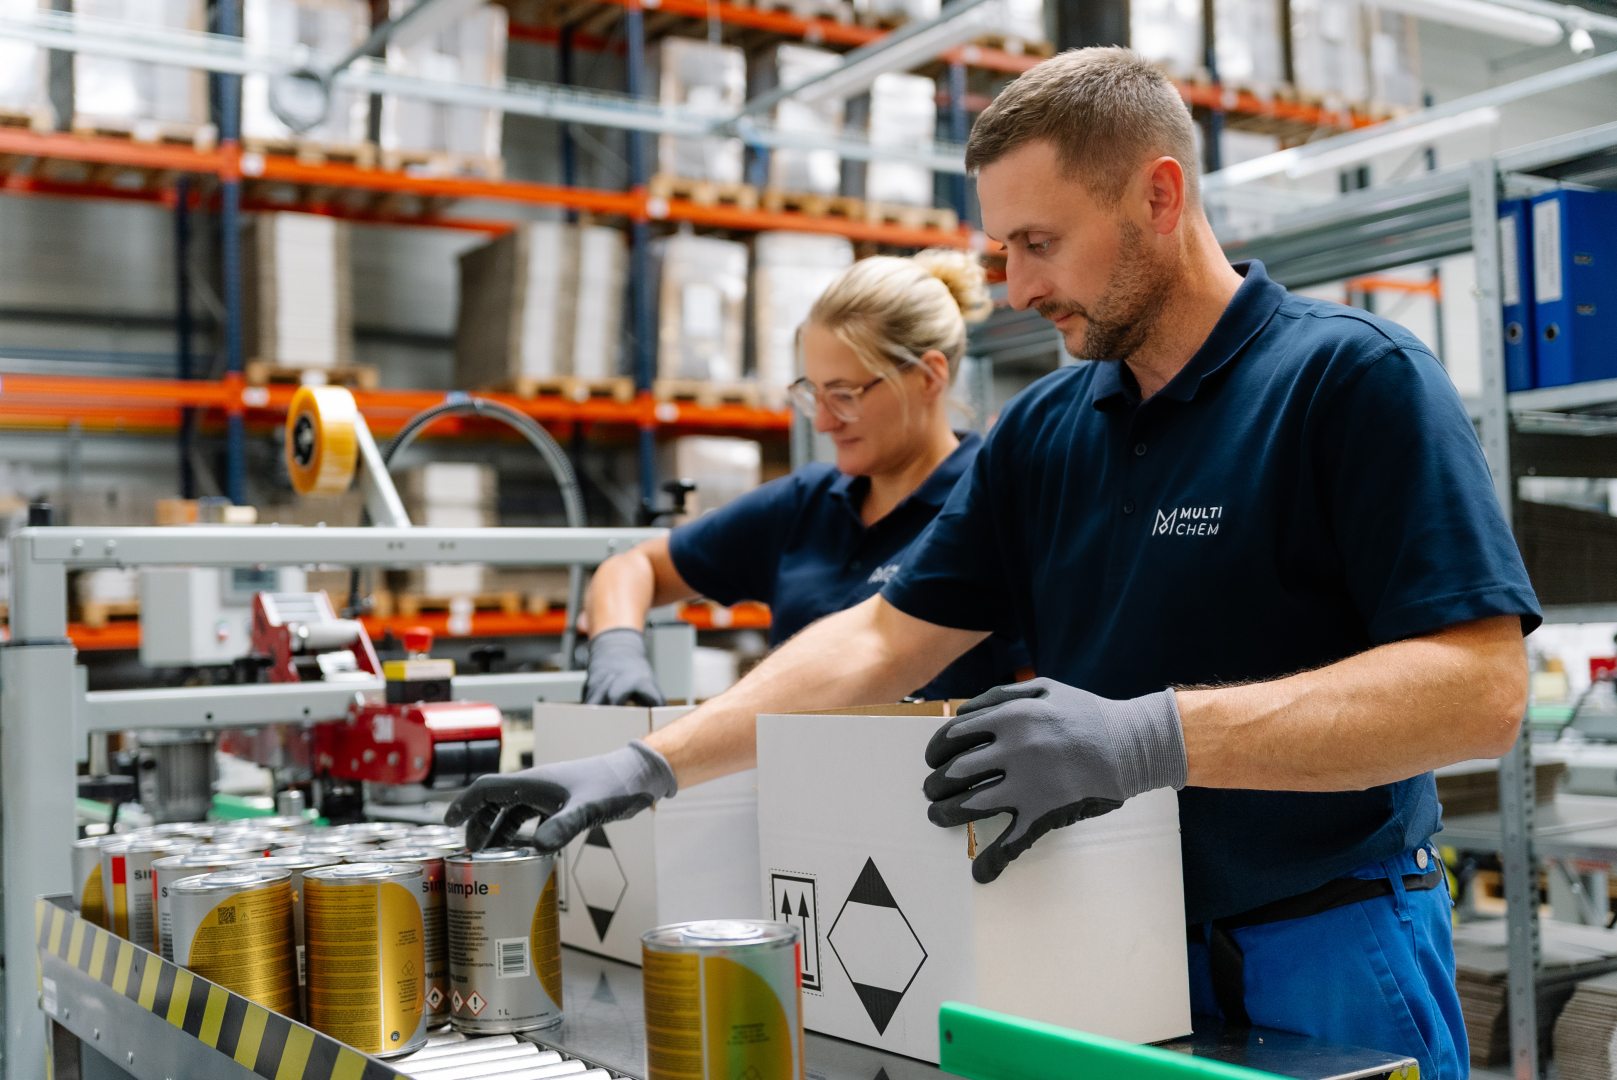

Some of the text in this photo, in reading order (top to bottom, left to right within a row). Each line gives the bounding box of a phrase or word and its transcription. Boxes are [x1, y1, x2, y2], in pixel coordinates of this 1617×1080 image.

[1180, 506, 1222, 519] MULTI
[1176, 522, 1219, 535] CHEM
[447, 878, 500, 898] simplex
[504, 1008, 510, 1016] L
